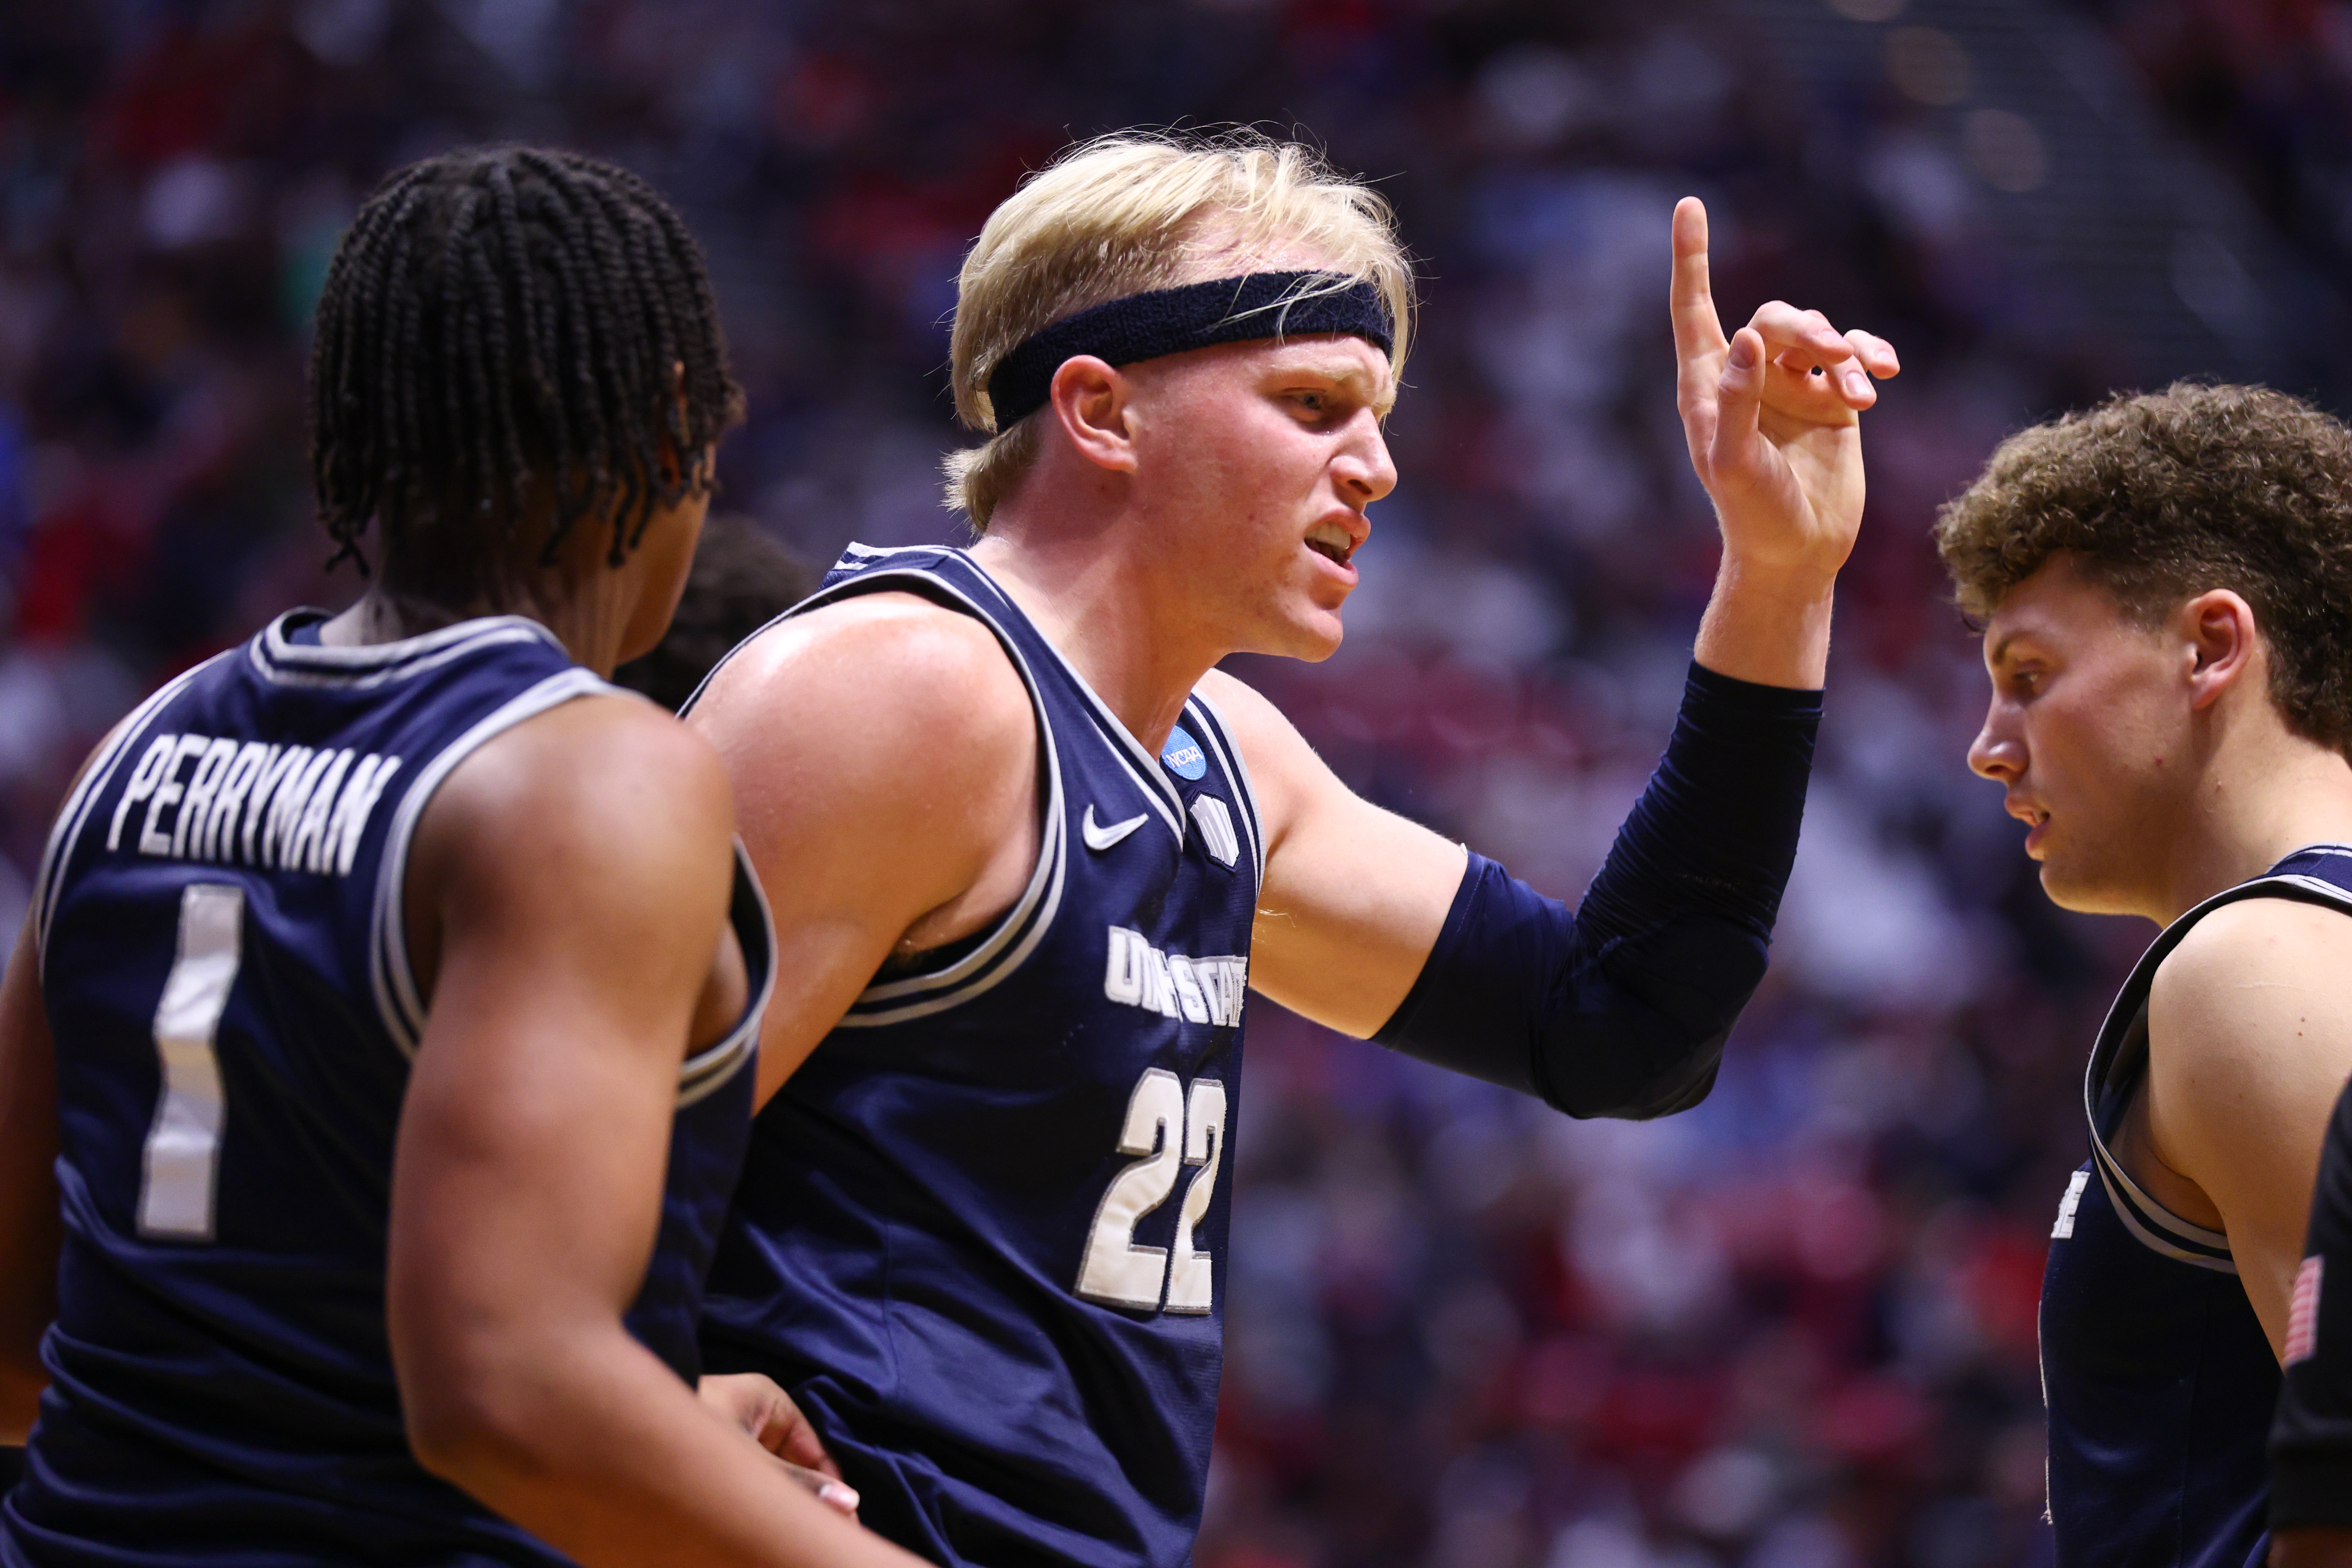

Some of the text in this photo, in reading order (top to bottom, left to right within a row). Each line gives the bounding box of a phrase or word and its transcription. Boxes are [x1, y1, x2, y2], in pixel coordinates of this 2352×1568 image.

[106, 733, 402, 877] PERRYMAN
[1165, 746, 1203, 768] NCAA
[136, 883, 245, 1241] 1
[1072, 1067, 1227, 1314] 22
